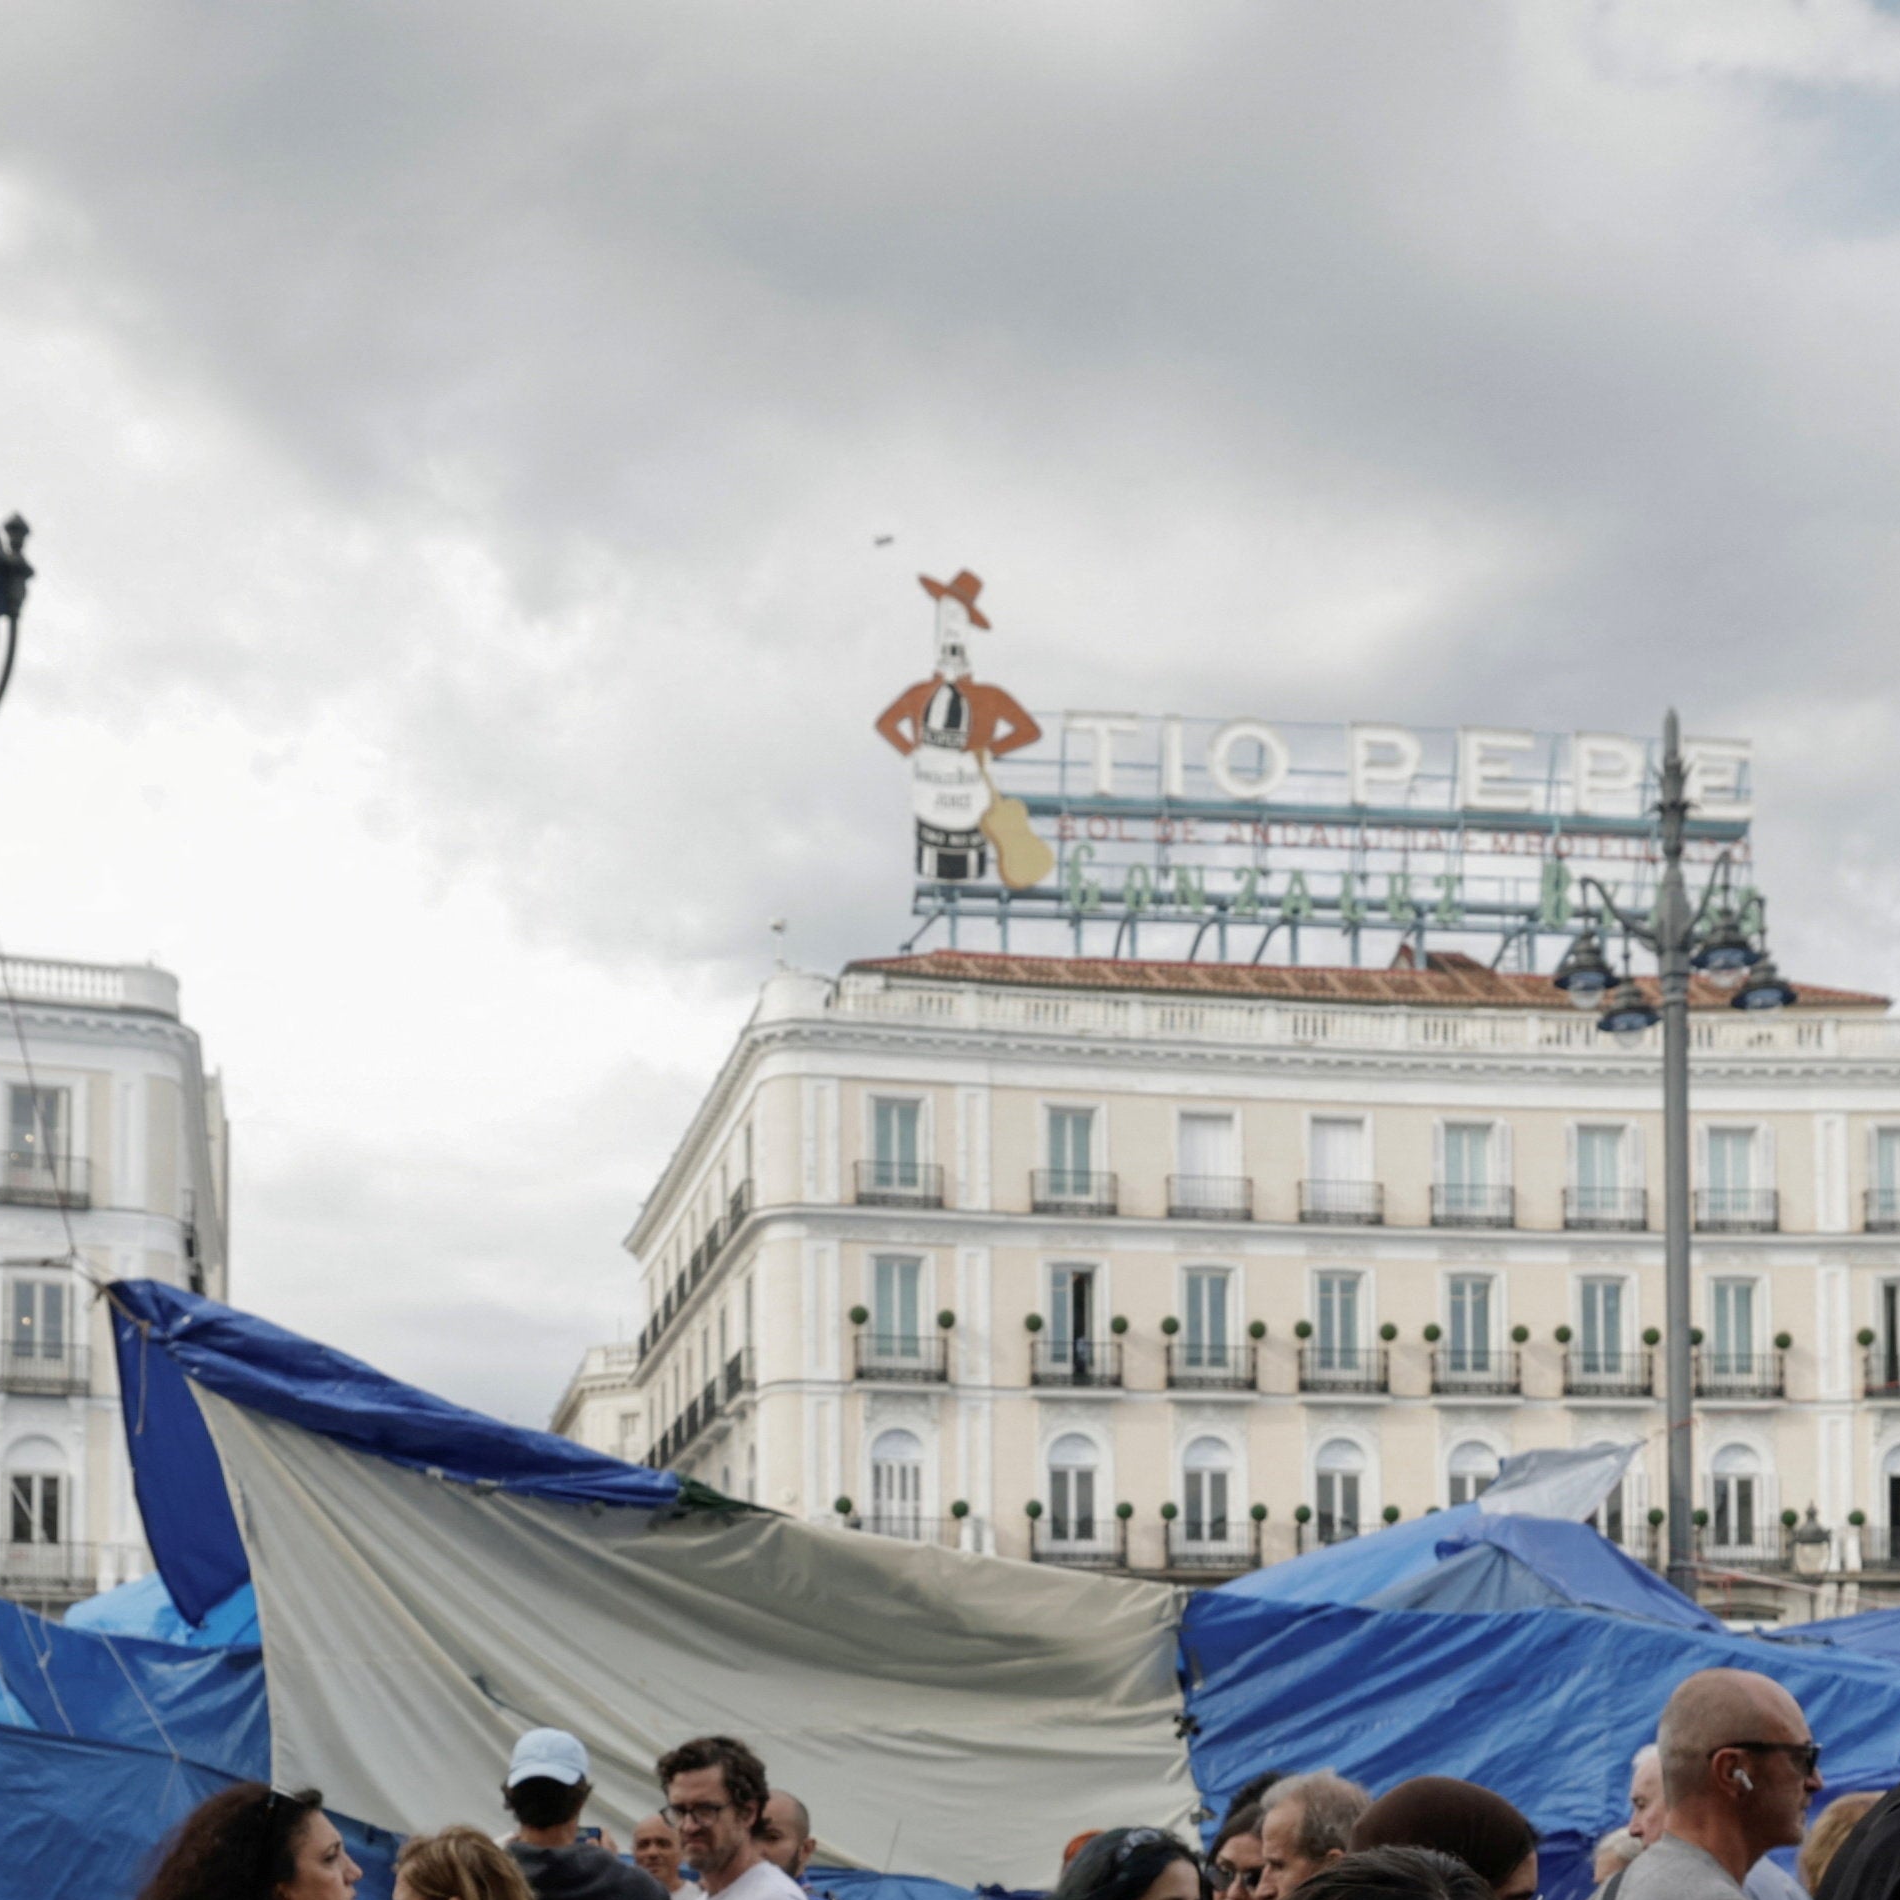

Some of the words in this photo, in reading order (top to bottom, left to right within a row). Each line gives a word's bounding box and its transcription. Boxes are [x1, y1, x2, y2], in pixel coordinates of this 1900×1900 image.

[1062, 709, 1290, 801] TIO
[1349, 719, 1753, 819] PEPE
[1153, 817, 1201, 844] DE
